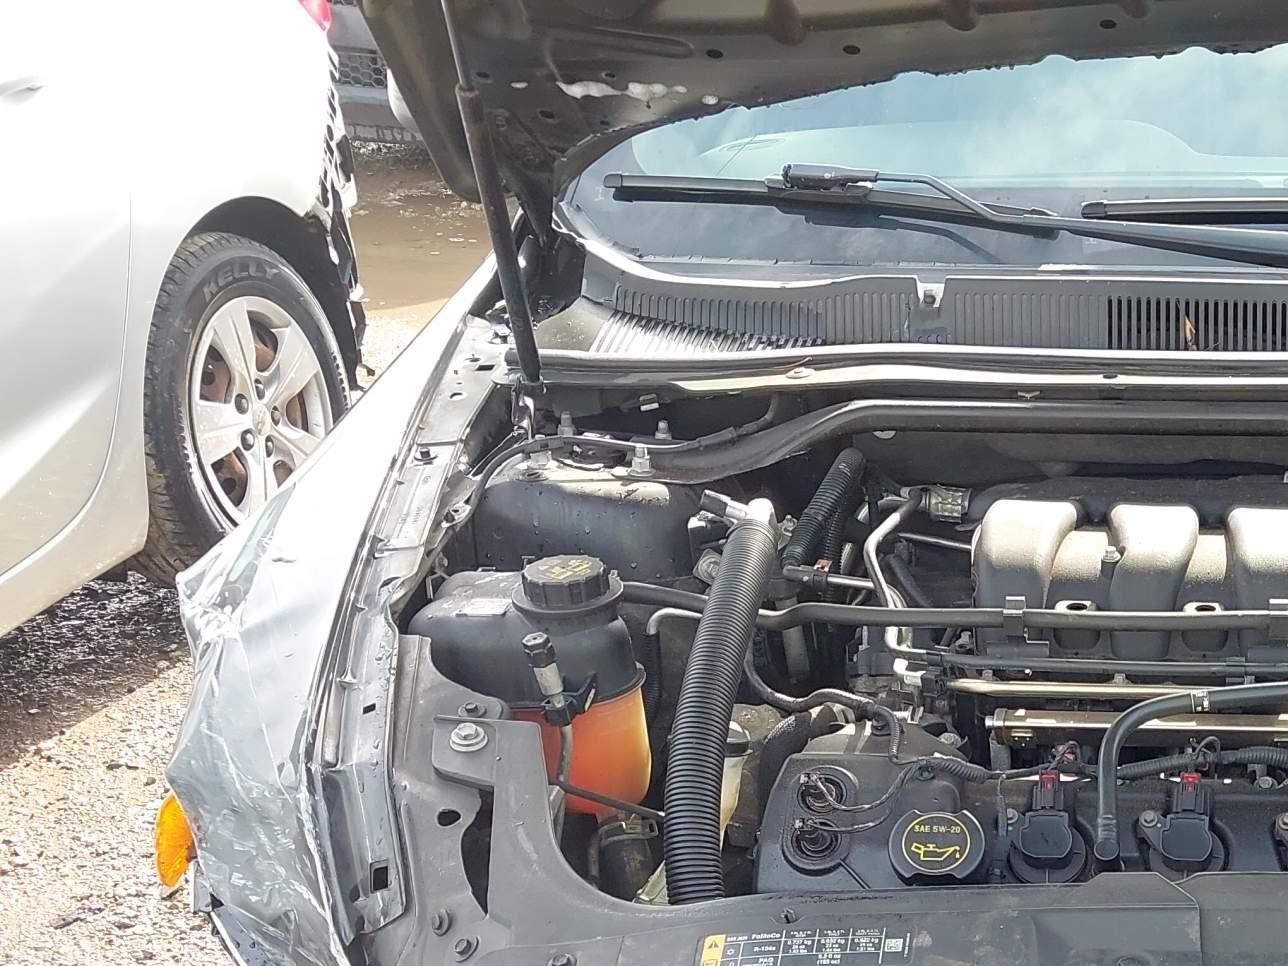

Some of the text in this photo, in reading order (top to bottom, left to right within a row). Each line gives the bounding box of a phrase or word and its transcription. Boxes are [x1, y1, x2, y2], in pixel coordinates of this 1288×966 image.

[202, 261, 280, 302] KELLY
[913, 825, 961, 834] SAE 5W-20
